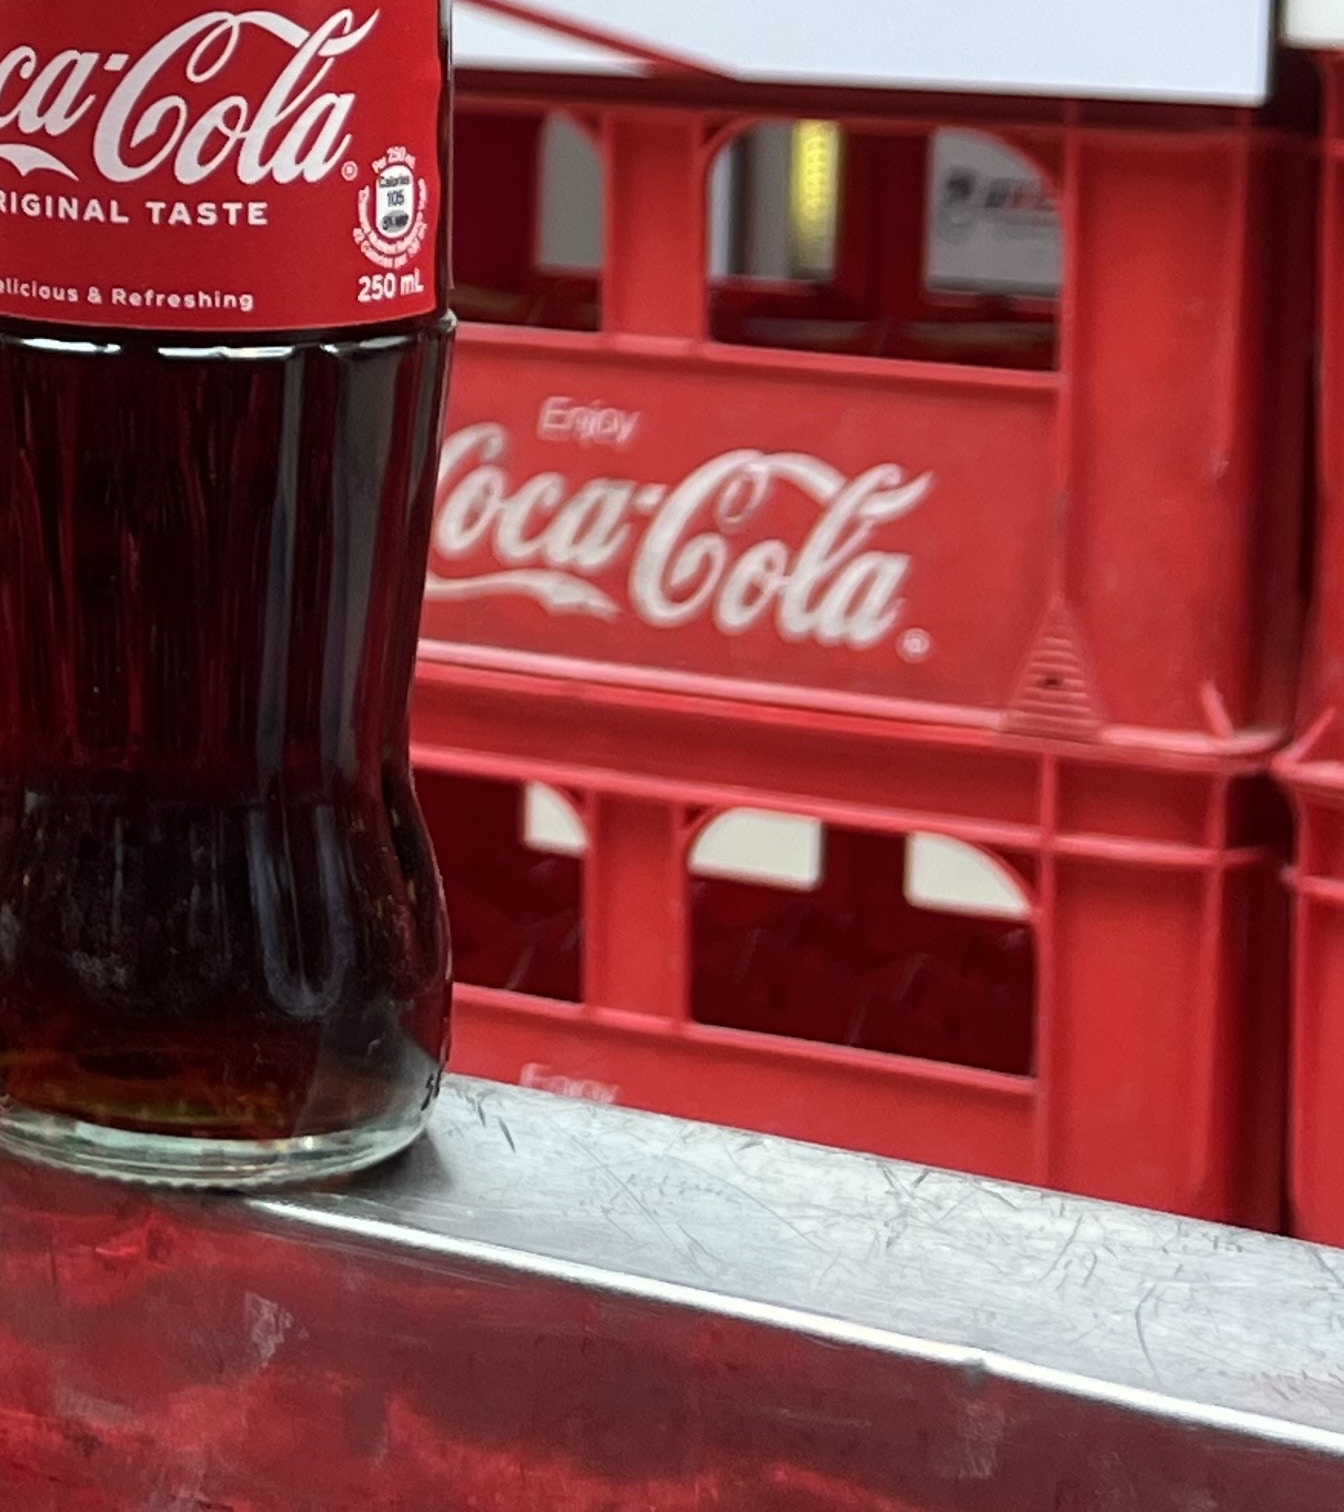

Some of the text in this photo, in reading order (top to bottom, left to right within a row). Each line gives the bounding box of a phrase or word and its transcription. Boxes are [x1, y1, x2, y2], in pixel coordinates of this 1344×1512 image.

[386, 188, 405, 208] 105
[146, 201, 269, 226] TASTE
[358, 267, 424, 302] 250 mL
[87, 286, 102, 305] &
[112, 288, 254, 312] Refreshing
[537, 395, 639, 448] Enjoy
